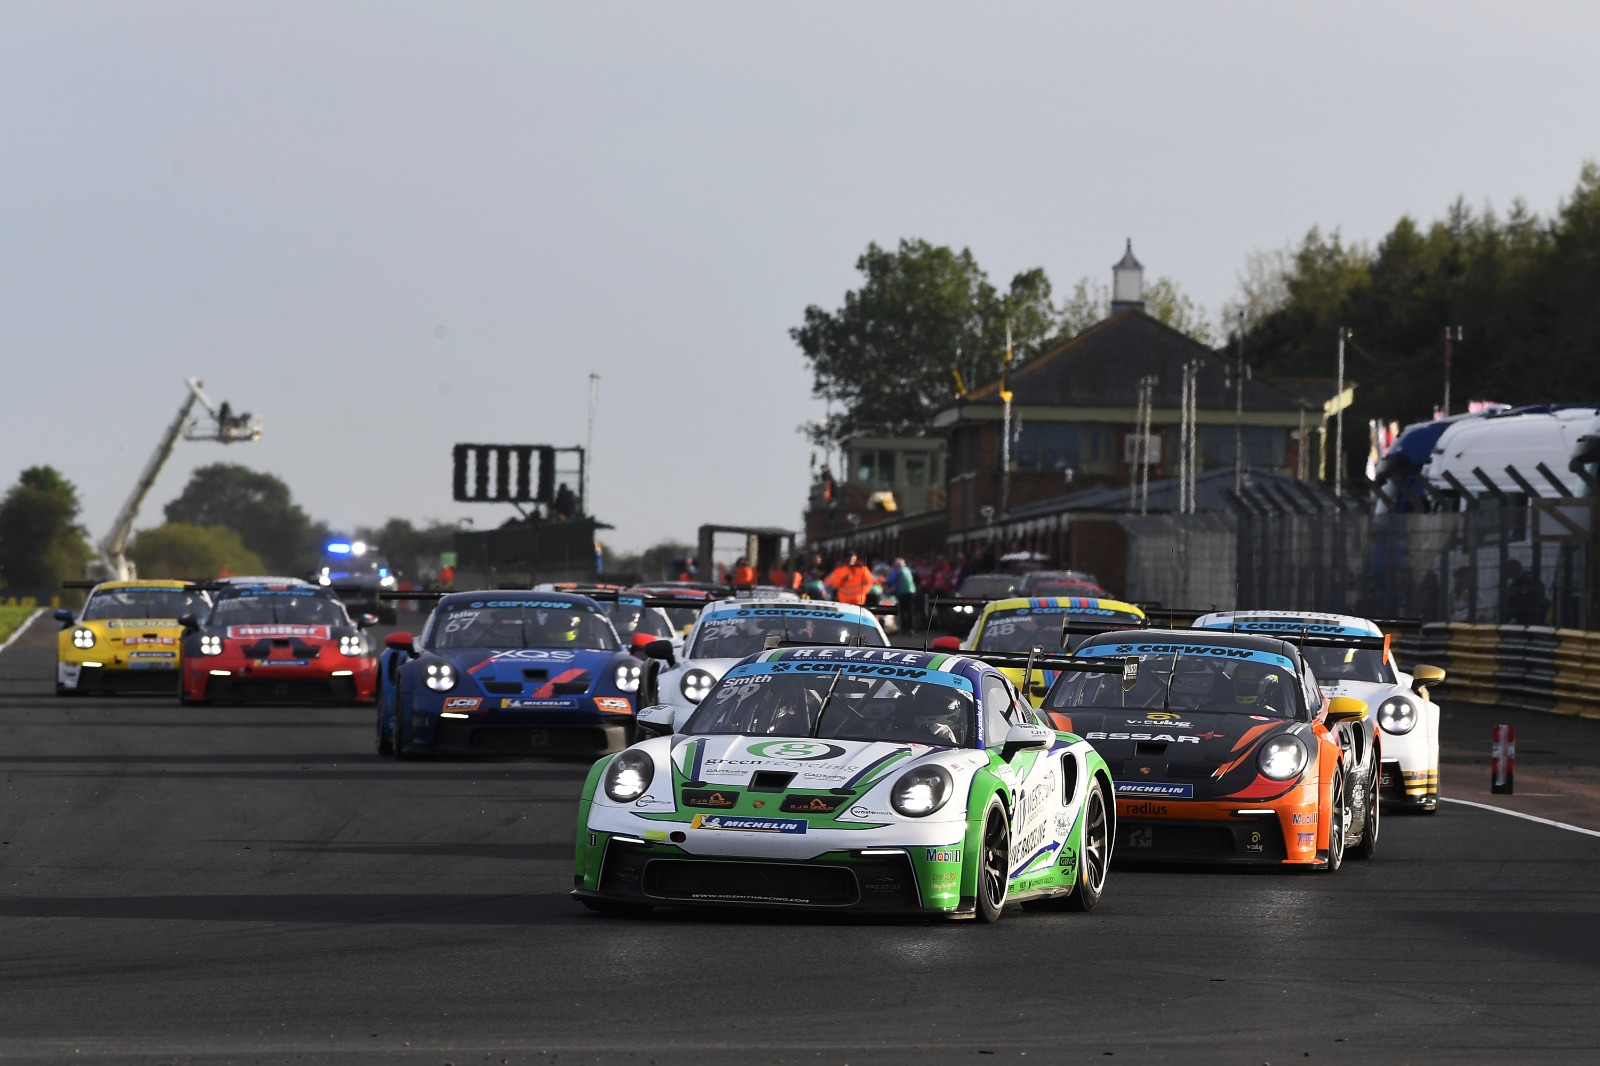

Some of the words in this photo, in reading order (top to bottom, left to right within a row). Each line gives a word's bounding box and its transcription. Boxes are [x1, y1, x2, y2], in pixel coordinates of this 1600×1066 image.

[486, 601, 572, 609] carwow
[448, 611, 481, 621] Jelley
[754, 609, 844, 619] carwow
[1033, 607, 1115, 616] carwow
[445, 617, 477, 633] 67
[704, 618, 746, 628] Phelps
[1247, 623, 1344, 634] carwow
[703, 625, 738, 642] 29
[984, 624, 1016, 638] 48
[491, 649, 576, 659] XQS
[793, 649, 924, 663] REVIVE
[1137, 645, 1254, 659] carwow
[795, 663, 928, 679] carwow
[723, 675, 773, 688] Smith
[447, 699, 479, 708] JCB
[716, 683, 760, 713] 99
[600, 699, 628, 709] JCB
[1085, 732, 1201, 744] ESSAR
[1118, 784, 1184, 794] MICHELIN
[1126, 802, 1168, 815] radius
[723, 819, 798, 830] MICHELIN
[926, 848, 954, 862] Mobil
[955, 849, 961, 863] 1
